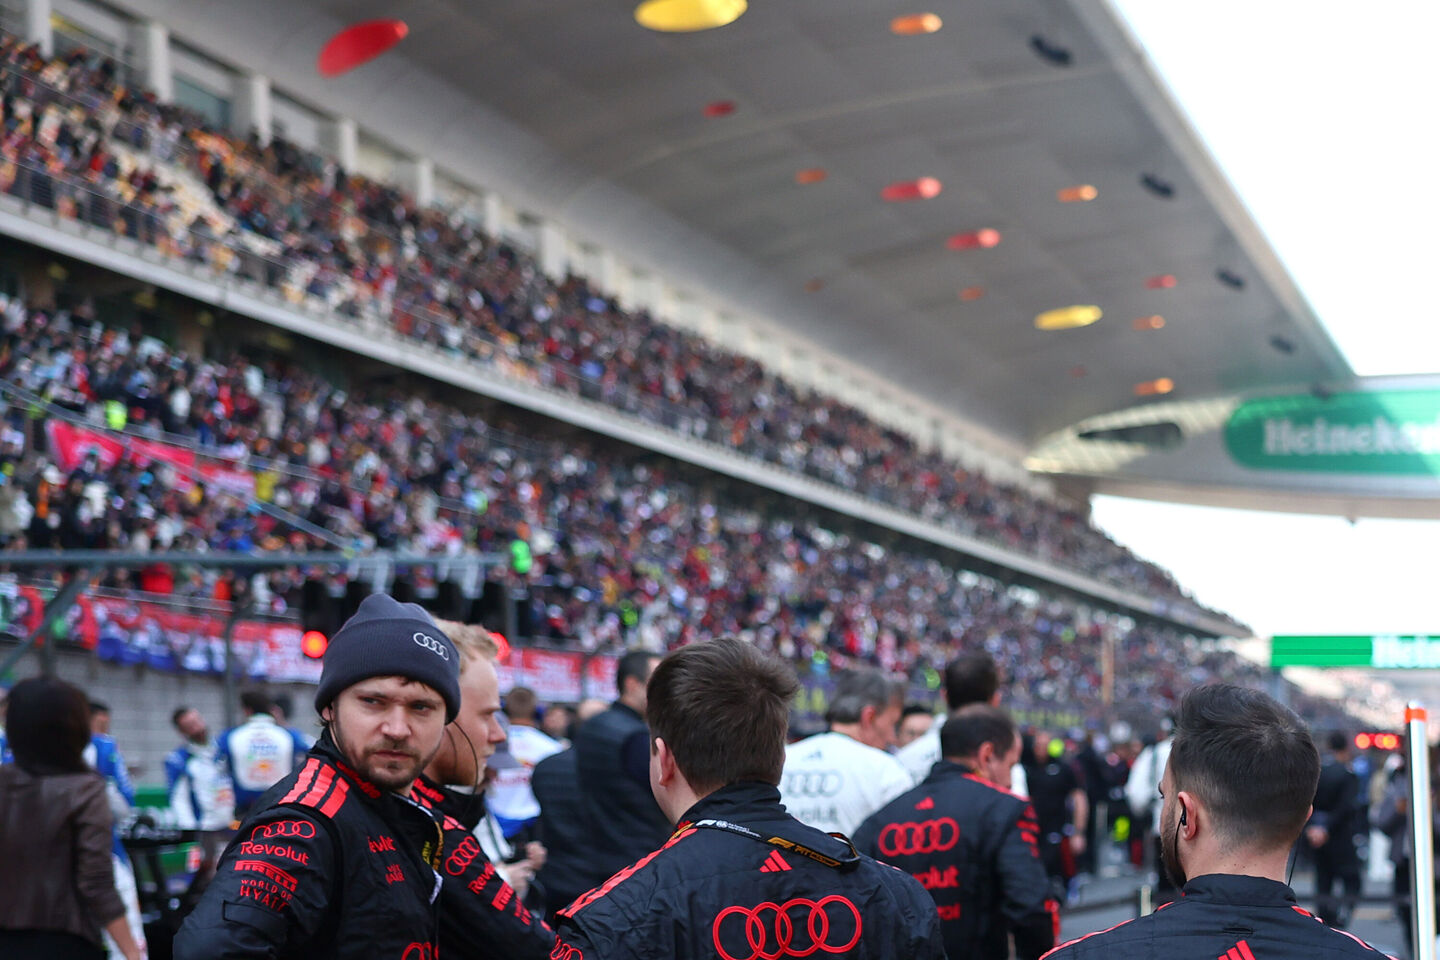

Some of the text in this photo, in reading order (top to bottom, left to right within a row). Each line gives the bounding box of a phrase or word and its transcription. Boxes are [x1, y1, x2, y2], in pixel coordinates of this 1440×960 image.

[240, 841, 309, 866] Revolut
[234, 860, 298, 892] PIRELLI
[241, 879, 279, 895] WORLD
[240, 885, 290, 912] HYATT
